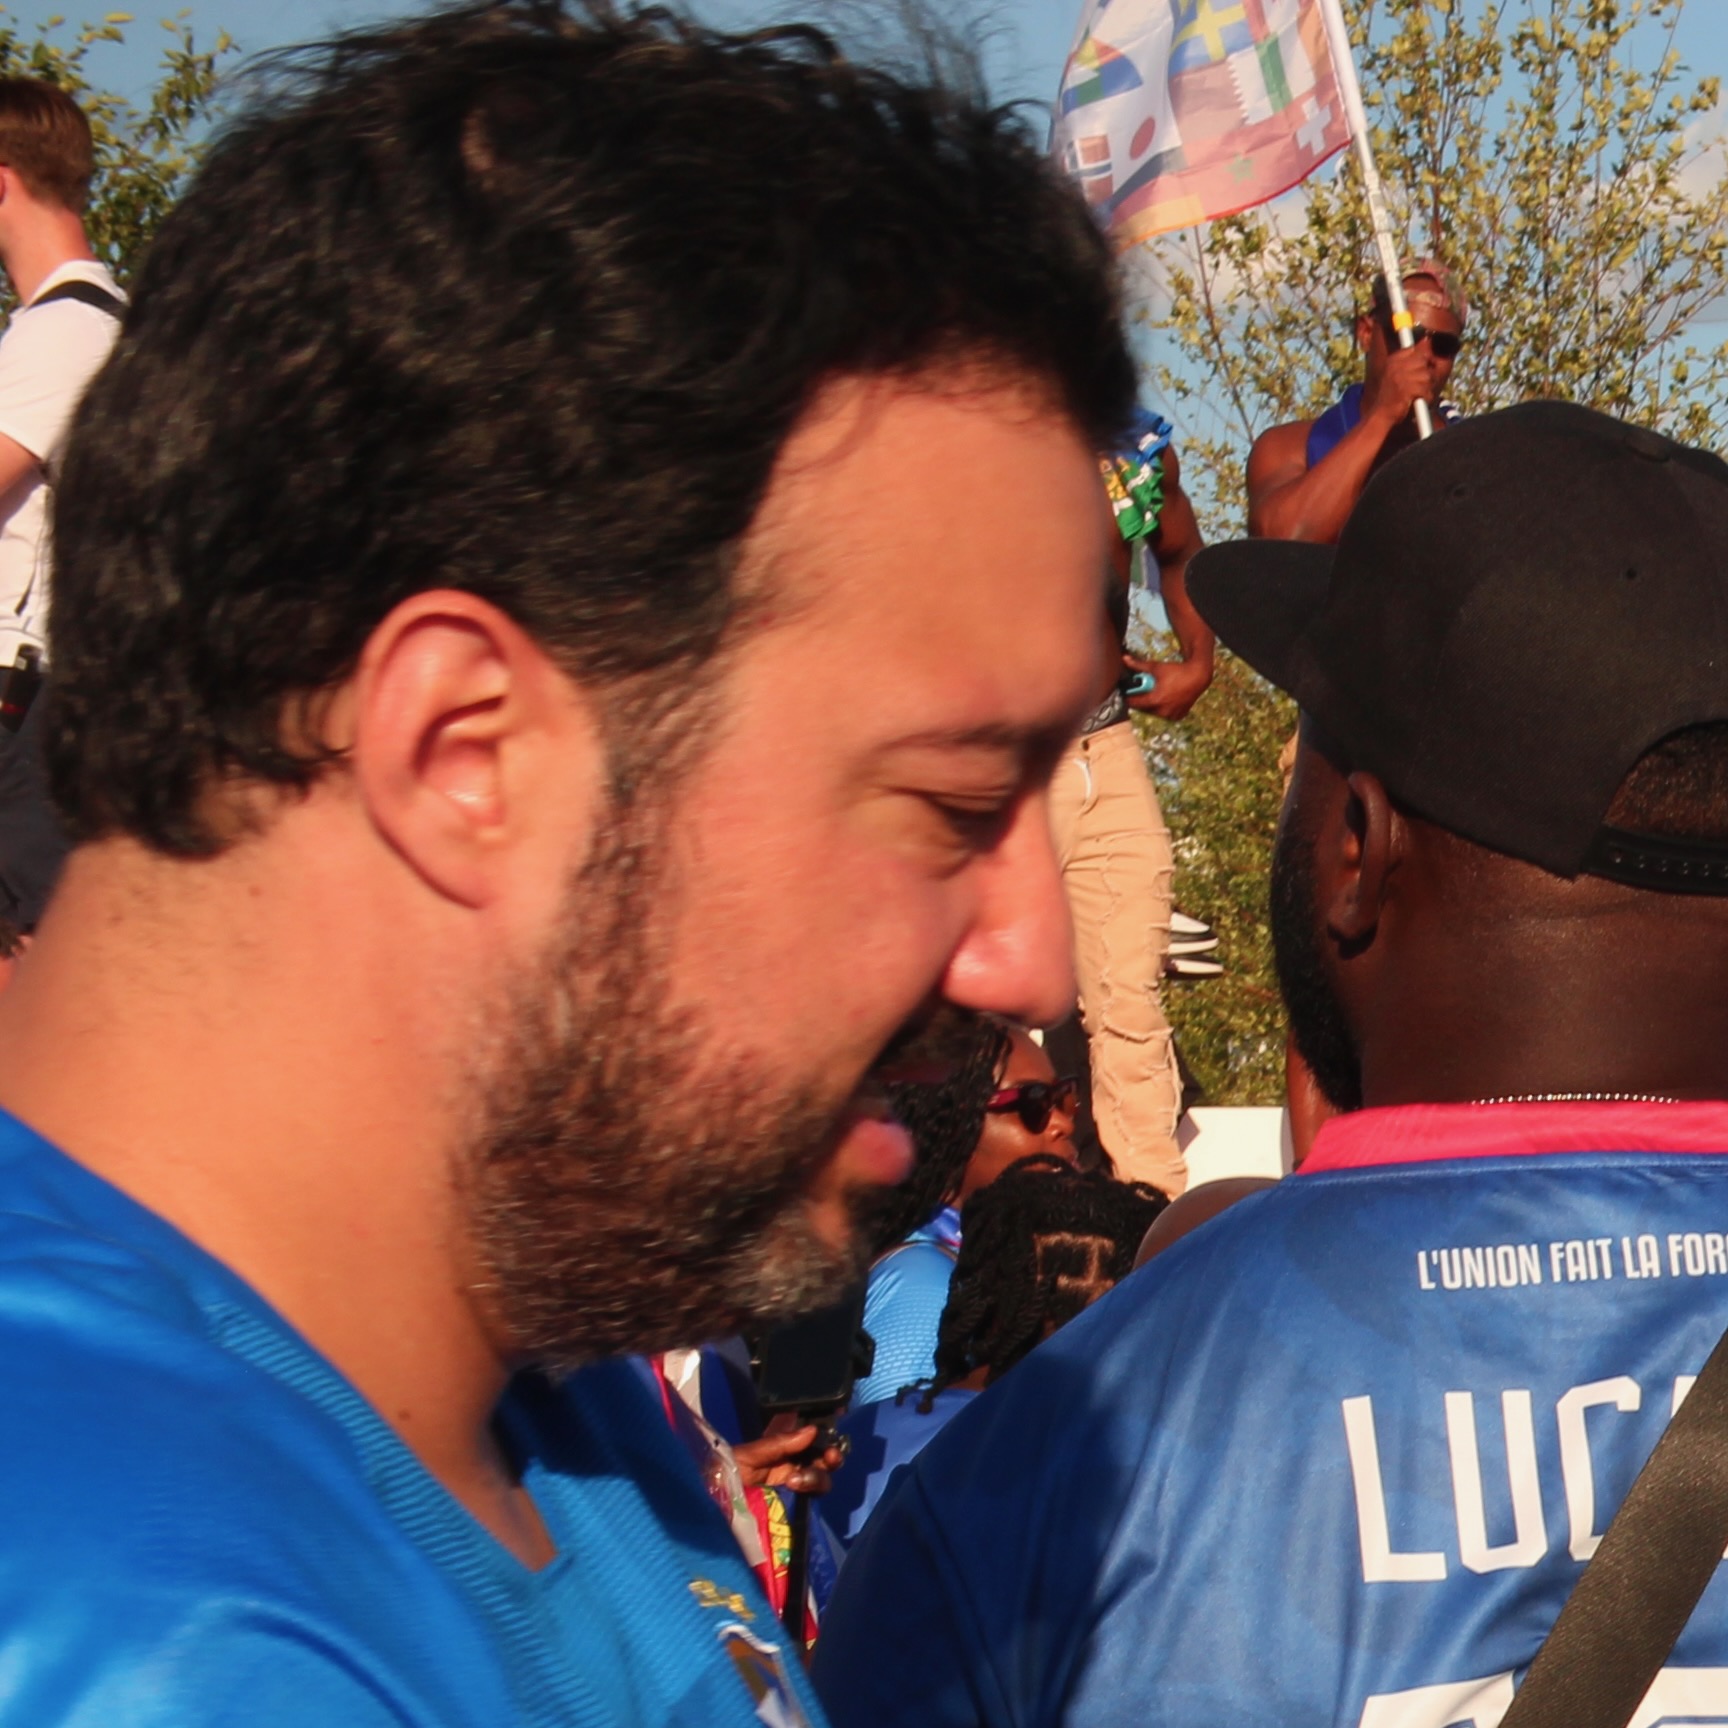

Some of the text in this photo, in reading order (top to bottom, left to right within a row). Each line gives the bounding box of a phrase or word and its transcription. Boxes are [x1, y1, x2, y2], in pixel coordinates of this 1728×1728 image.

[1417, 1243, 1541, 1290] L'UNION
[1549, 1236, 1612, 1283] FAIT
[1621, 1234, 1661, 1279] LA
